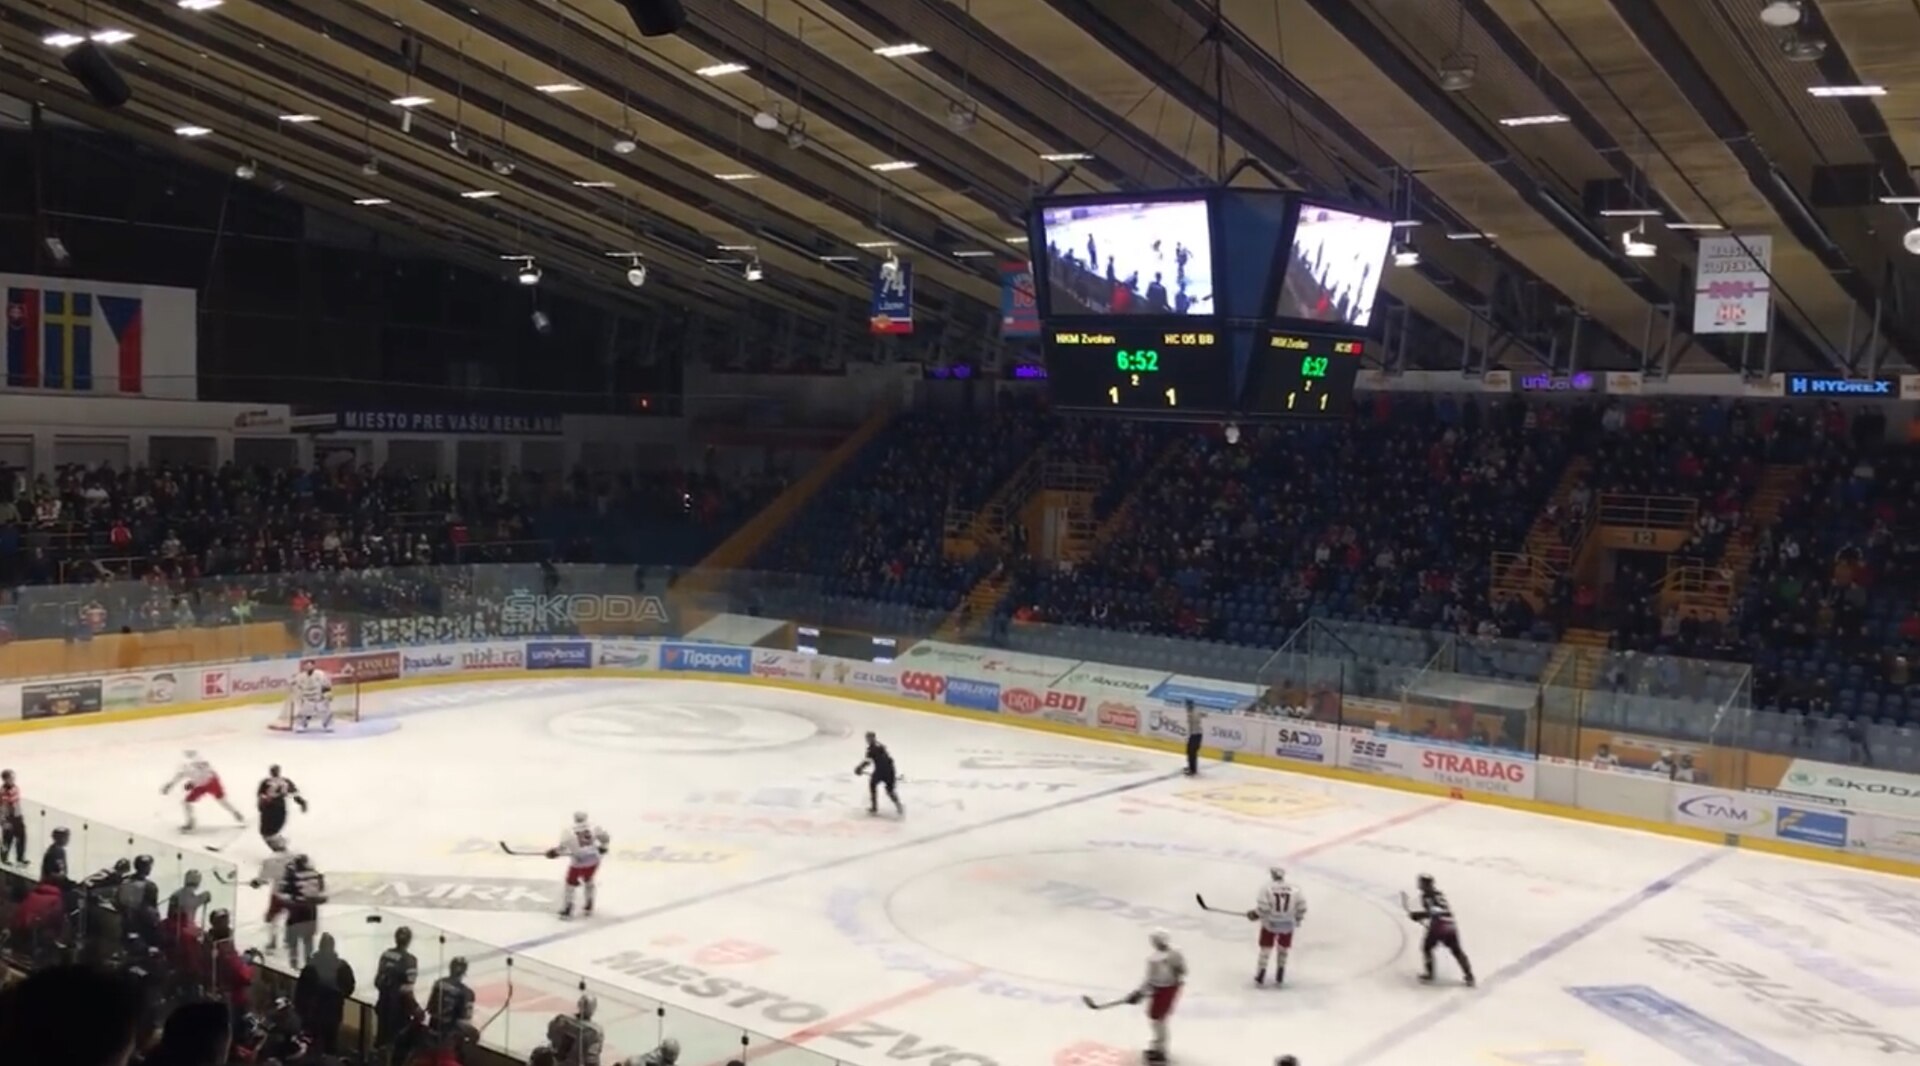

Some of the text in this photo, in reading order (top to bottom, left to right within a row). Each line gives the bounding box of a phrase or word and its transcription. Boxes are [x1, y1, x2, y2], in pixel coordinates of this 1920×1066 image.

[1056, 334, 1116, 345] HKM Zvolen
[1165, 334, 1181, 345] HC
[1117, 350, 1159, 371] 6:52
[1302, 356, 1328, 376] 6:52
[1131, 374, 1140, 386] 2
[1812, 379, 1889, 393] HYDREX
[1109, 386, 1119, 404] 1
[1166, 388, 1176, 406] 1
[1287, 392, 1296, 409] 1
[1320, 393, 1329, 410] 1
[346, 411, 407, 429] MIESTO
[412, 413, 443, 430] PRE
[450, 412, 489, 431] VAŠU
[502, 588, 670, 624] ŠKODA
[682, 649, 744, 669] Tipsport
[232, 676, 293, 692] Kauflan
[1045, 690, 1087, 712] BDI
[1422, 751, 1524, 783] STRABAG
[1702, 803, 1748, 822] TAM
[1273, 892, 1291, 913] 17
[592, 950, 829, 1025] MESTO
